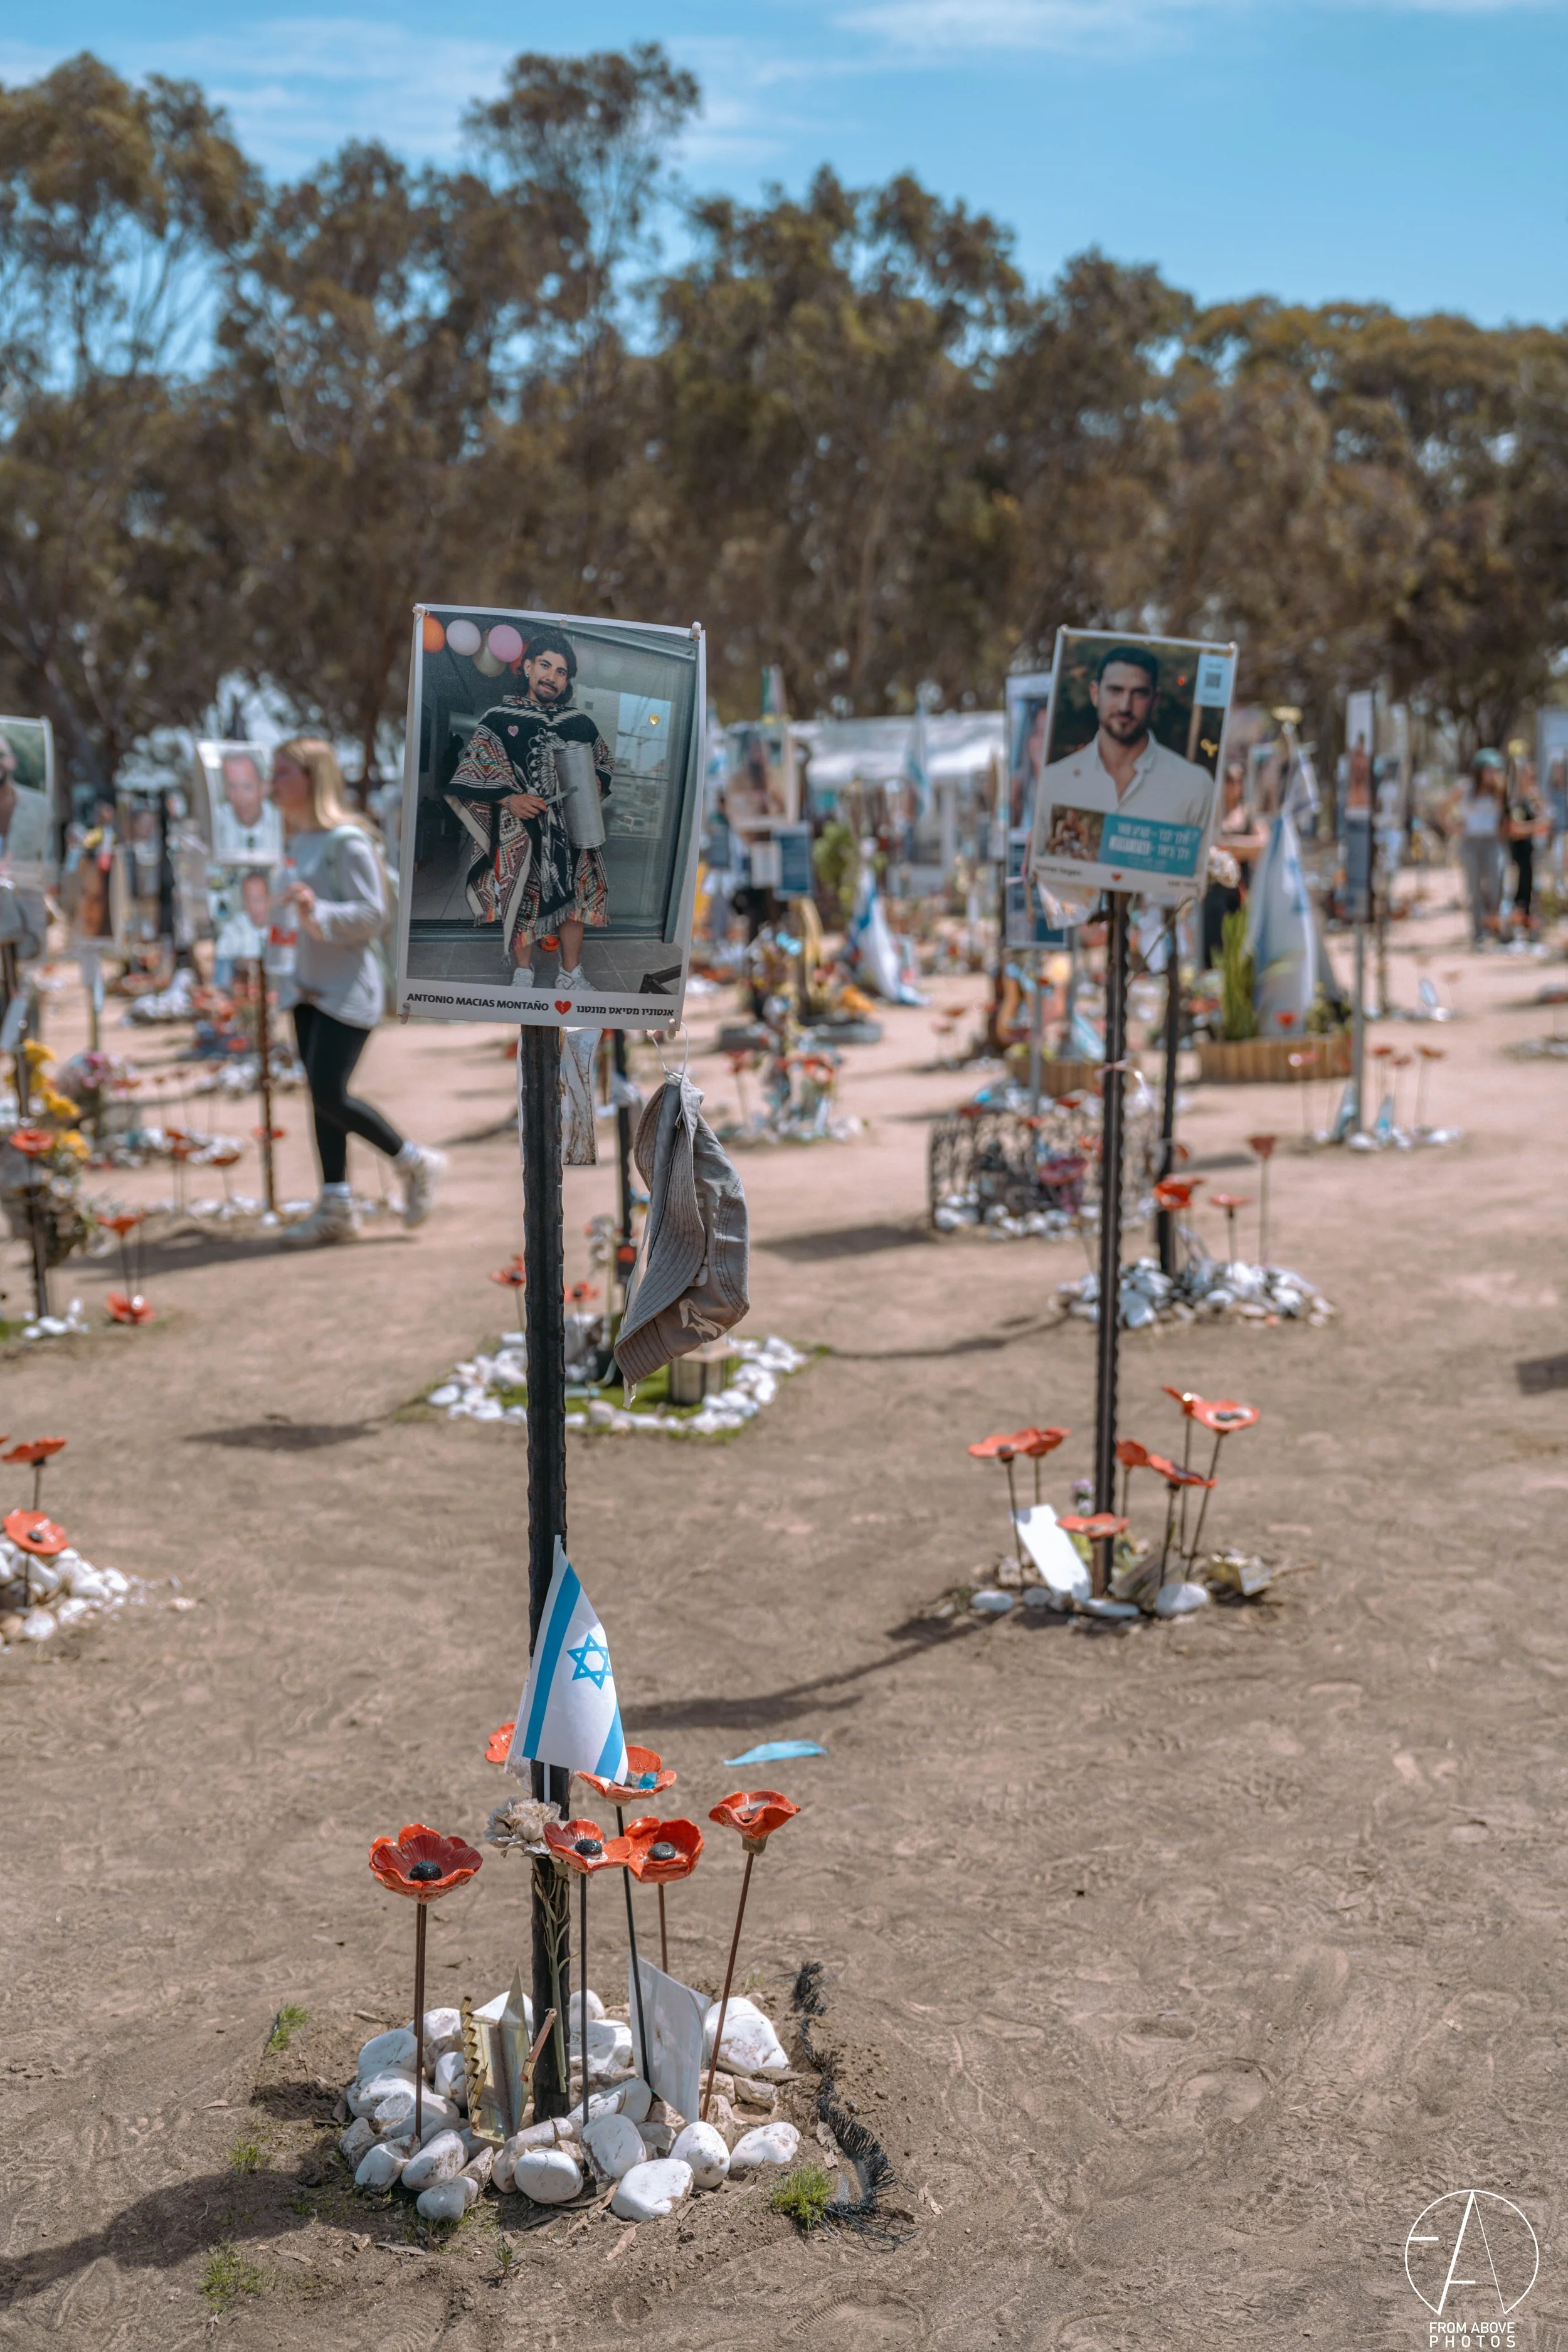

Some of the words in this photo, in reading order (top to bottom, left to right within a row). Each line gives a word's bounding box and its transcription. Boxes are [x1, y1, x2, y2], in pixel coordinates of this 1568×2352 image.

[406, 993, 454, 1004] ANTONIO
[455, 997, 495, 1007] MACIAS
[496, 1000, 549, 1011] MONTAÑO
[576, 1005, 607, 1014] מונטנו
[608, 1007, 640, 1015] מסיאס
[642, 1008, 674, 1016] אנטוניו
